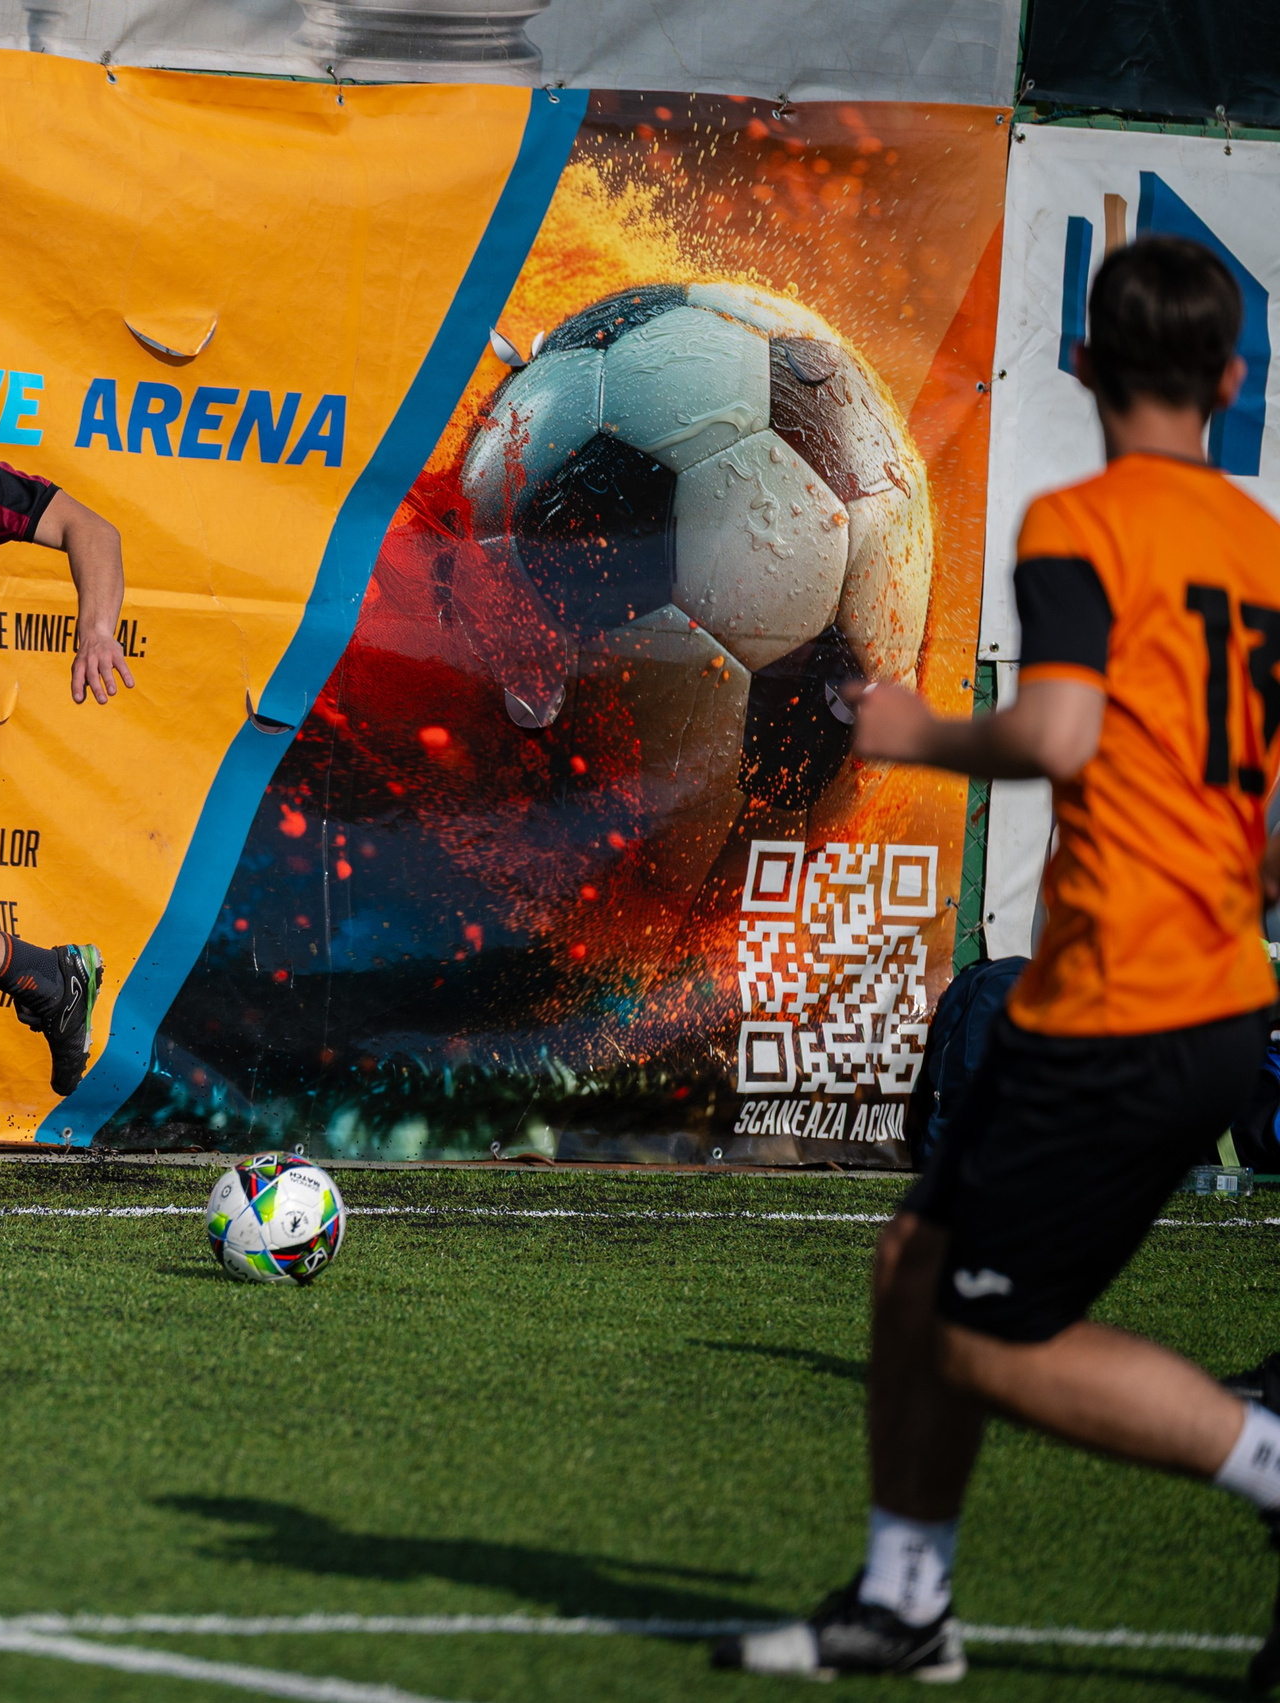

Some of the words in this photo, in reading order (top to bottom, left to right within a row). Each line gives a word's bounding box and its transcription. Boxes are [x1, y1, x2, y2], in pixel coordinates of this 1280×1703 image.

[74, 377, 347, 469] ARENA
[733, 1099, 848, 1140] SCANEAZA
[849, 1102, 906, 1143] ACUM
